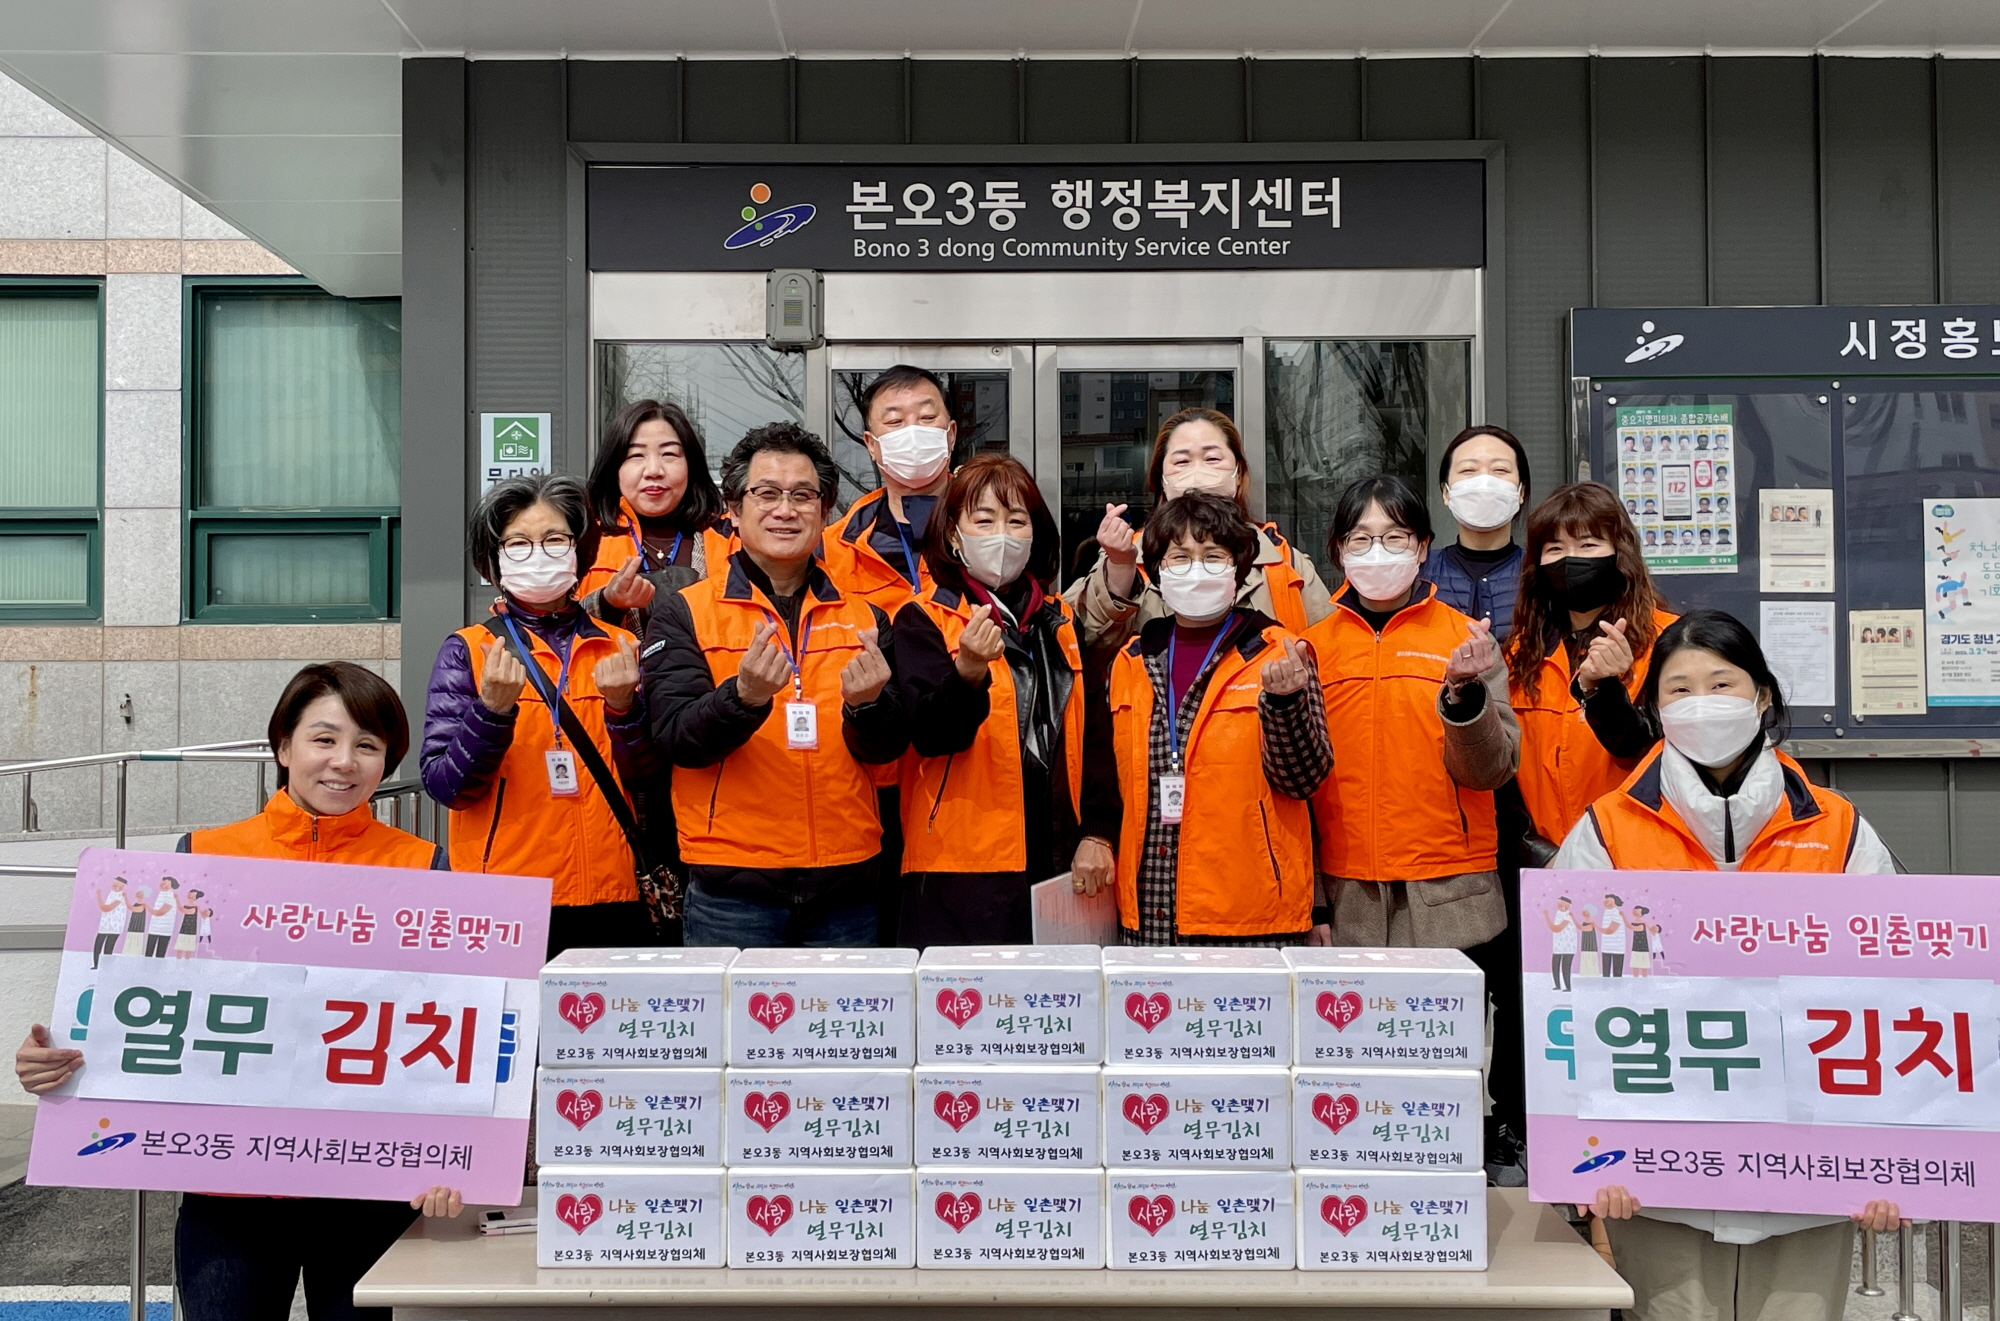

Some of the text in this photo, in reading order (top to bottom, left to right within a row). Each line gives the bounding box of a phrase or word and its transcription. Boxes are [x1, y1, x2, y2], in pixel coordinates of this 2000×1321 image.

[846, 177, 1342, 231] 본오3동 행정복지센터
[853, 237, 1291, 262] Bono 3 dong Community Service Center
[1680, 413, 1728, 425] 종합공개수배
[1667, 482, 1687, 493] 112
[1941, 634, 1971, 644] 경기도
[1974, 634, 1993, 644] 청년
[243, 903, 523, 953] 사랑나눔 일촌맺기
[1693, 914, 1988, 959] 사랑나눔 일촌맺기
[567, 997, 706, 1024] 사랑 나눔 일촌맺기
[758, 997, 895, 1025] 사랑 나눔 일촌맺기
[945, 992, 1082, 1021] 사랑 나눔 일촌맺기
[1133, 996, 1273, 1024] 사랑 나눔 일촌맺기
[1324, 996, 1465, 1023] 사랑 나눔 일촌맺기
[113, 985, 274, 1076] 열무
[321, 999, 478, 1086] 김치
[618, 1018, 696, 1040] 열무김치
[808, 1018, 885, 1040] 열무김치
[995, 1013, 1073, 1035] 열무김치
[1185, 1017, 1263, 1039] 열무김치
[1376, 1017, 1455, 1039] 열무김치
[556, 1046, 709, 1061] 본오3동 지역사회보장협의체
[746, 1046, 898, 1061] 본오3동 지역사회보장협의체
[934, 1041, 1086, 1056] 본오3동 지역사회보장협의체
[1124, 1045, 1277, 1060] 본오3동 지역사회보장협의체
[1314, 1045, 1469, 1060] 본오3동 지역사회보장협의체
[1595, 1006, 1761, 1094] 열무
[1806, 1006, 1975, 1097] 김치
[565, 1094, 703, 1121] 사랑 나눔 일촌맺기
[752, 1095, 891, 1124] 사랑 나눔 일촌맺기
[942, 1096, 1081, 1123] 사랑 나눔 일촌맺기
[1131, 1097, 1271, 1126] 사랑 나눔 일촌맺기
[1320, 1100, 1462, 1125] 사랑 나눔 일촌맺기
[615, 1115, 693, 1138] 열무김치
[803, 1117, 881, 1139] 열무김치
[993, 1117, 1071, 1140] 열무김치
[1183, 1118, 1261, 1141] 열무김치
[1372, 1121, 1451, 1144] 열무김치
[141, 1129, 474, 1171] 본오3동 지역사회보장협의체
[553, 1144, 706, 1159] 본오3동 지역사회보장협의체
[742, 1144, 895, 1160] 본오3동 지역사회보장협의체
[932, 1146, 1084, 1161] 본오3동 지역사회보장협의체
[1122, 1146, 1275, 1162] 본오3동 지역사회보장협의체
[1309, 1148, 1464, 1165] 본오3동 지역사회보장협의체
[1633, 1148, 1976, 1188] 본오3동 지역사회보장협의체
[564, 1198, 704, 1225] 사랑 나눔 일촌맺기
[755, 1197, 894, 1227] 사랑 나눔 일촌맺기
[943, 1197, 1083, 1224] 사랑 나눔 일촌맺기
[1137, 1197, 1276, 1227] 사랑 나눔 일촌맺기
[1329, 1199, 1470, 1227] 사랑 나눔 일촌맺기
[616, 1219, 694, 1241] 열무김치
[806, 1219, 885, 1242] 열무김치
[995, 1218, 1073, 1240] 열무김치
[1189, 1219, 1267, 1241] 열무김치
[1381, 1220, 1460, 1243] 열무김치
[554, 1247, 707, 1262] 본오3동 지역사회보장협의체
[745, 1246, 898, 1264] 본오3동 지역사회보장협의체
[933, 1246, 1086, 1261] 본오3동 지역사회보장협의체
[1128, 1246, 1281, 1264] 본오3동 지역사회보장협의체
[1319, 1249, 1474, 1264] 본오3동 지역사회보장협의체
